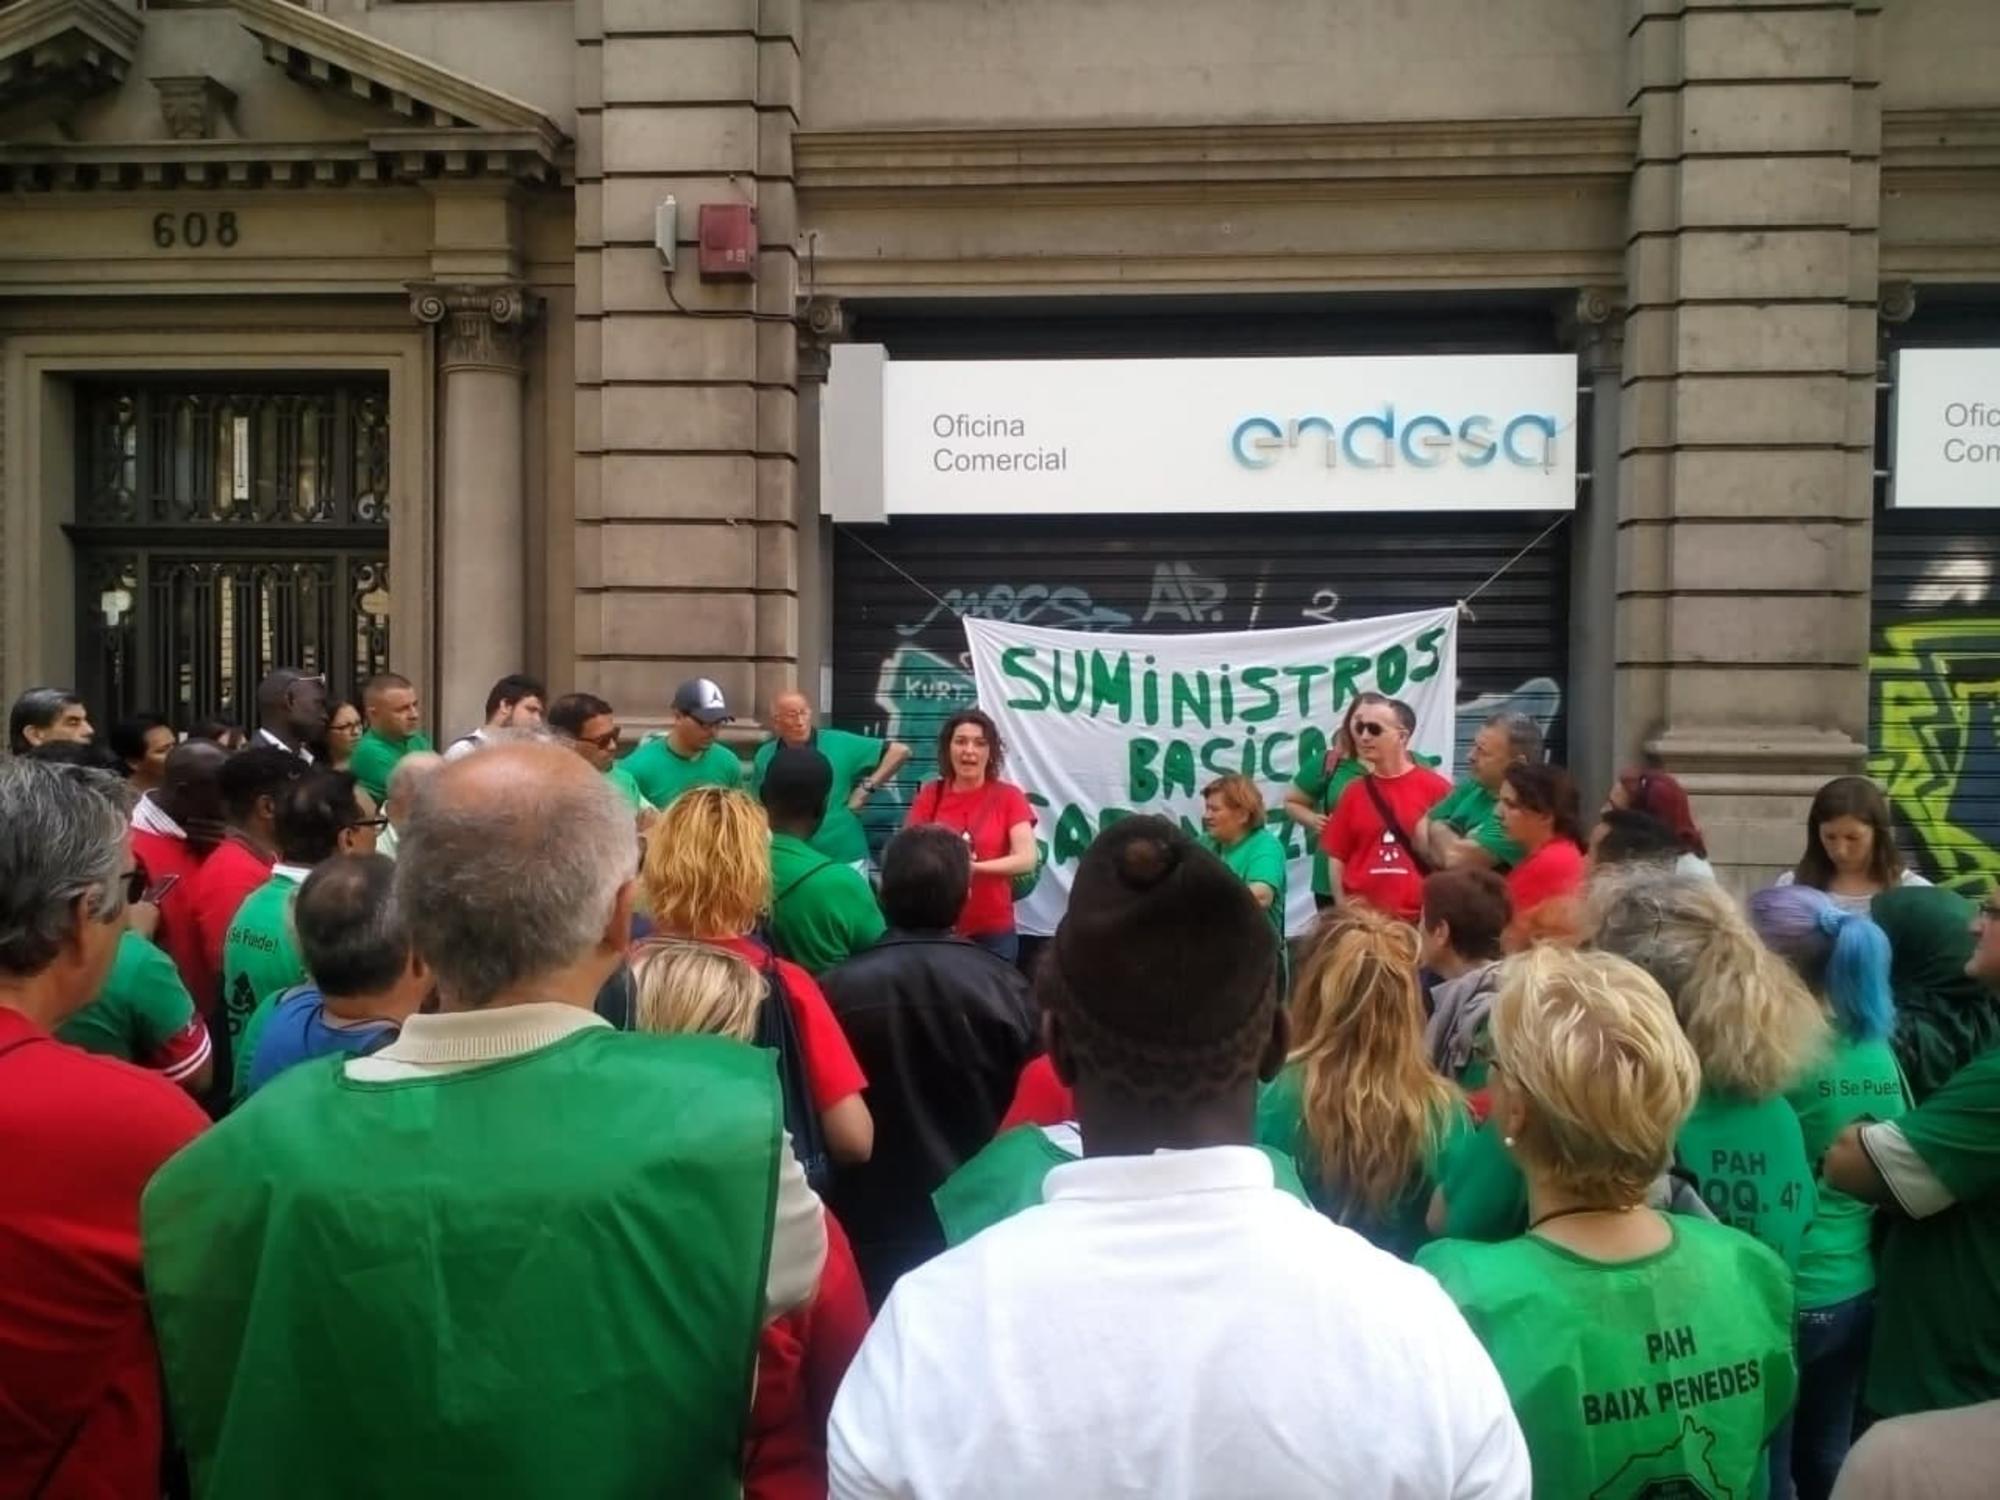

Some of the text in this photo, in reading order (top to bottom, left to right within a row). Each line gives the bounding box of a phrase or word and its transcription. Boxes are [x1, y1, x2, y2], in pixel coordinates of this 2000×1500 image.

[153, 211, 239, 248] 608
[933, 413, 1025, 438] Oficina
[1232, 401, 1556, 471] endesa
[933, 446, 1067, 472] Comercial
[1840, 1078, 1860, 1096] Se
[1711, 1149, 1767, 1176] PAH
[1645, 1324, 1698, 1364] PAH
[1582, 1359, 1761, 1426] BAIX PENEDES
